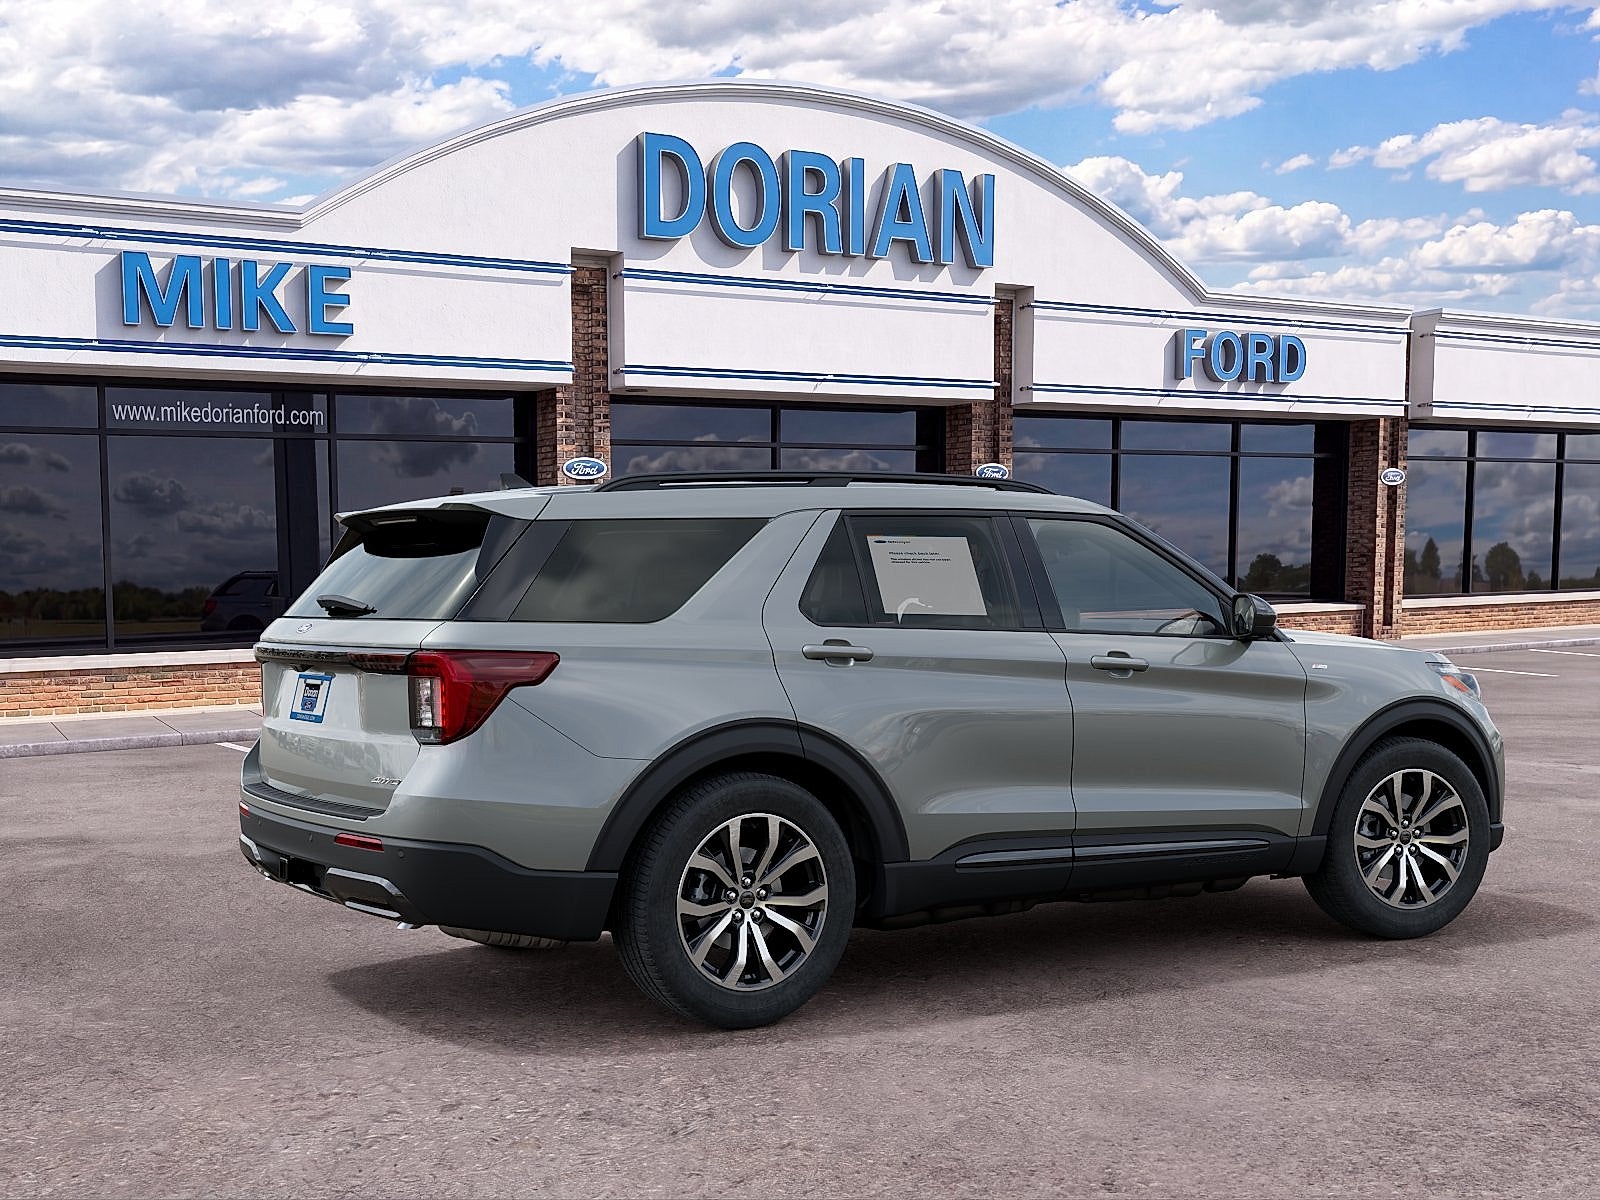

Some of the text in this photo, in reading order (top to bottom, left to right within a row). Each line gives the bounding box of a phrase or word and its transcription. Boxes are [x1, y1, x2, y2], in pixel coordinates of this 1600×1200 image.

[638, 131, 996, 269] DORIAN
[120, 250, 354, 336] MIKE
[1178, 328, 1307, 384] FORD
[112, 401, 324, 426] www.mikedorianford.com
[571, 462, 599, 475] Ford
